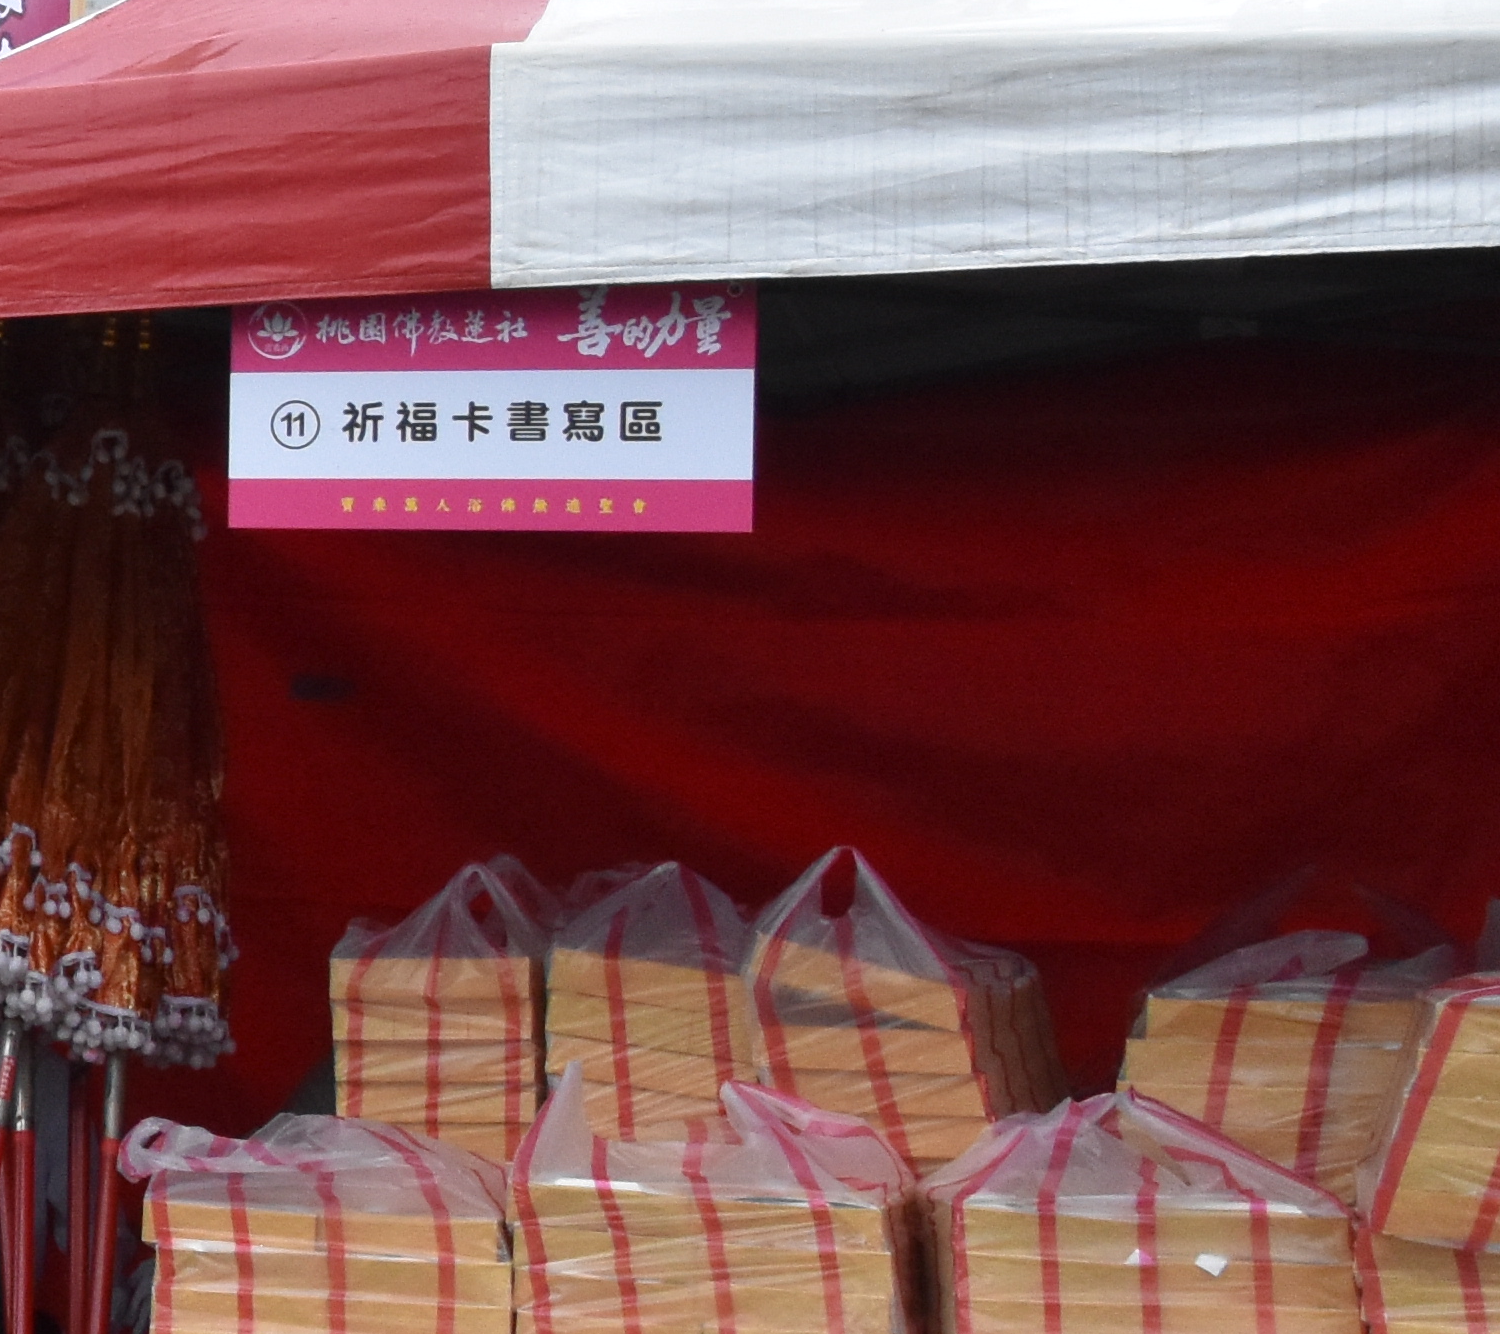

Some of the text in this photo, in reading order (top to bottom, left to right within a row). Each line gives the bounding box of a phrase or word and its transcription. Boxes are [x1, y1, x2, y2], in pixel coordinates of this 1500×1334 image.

[340, 399, 664, 444] 祈福卡書寫區
